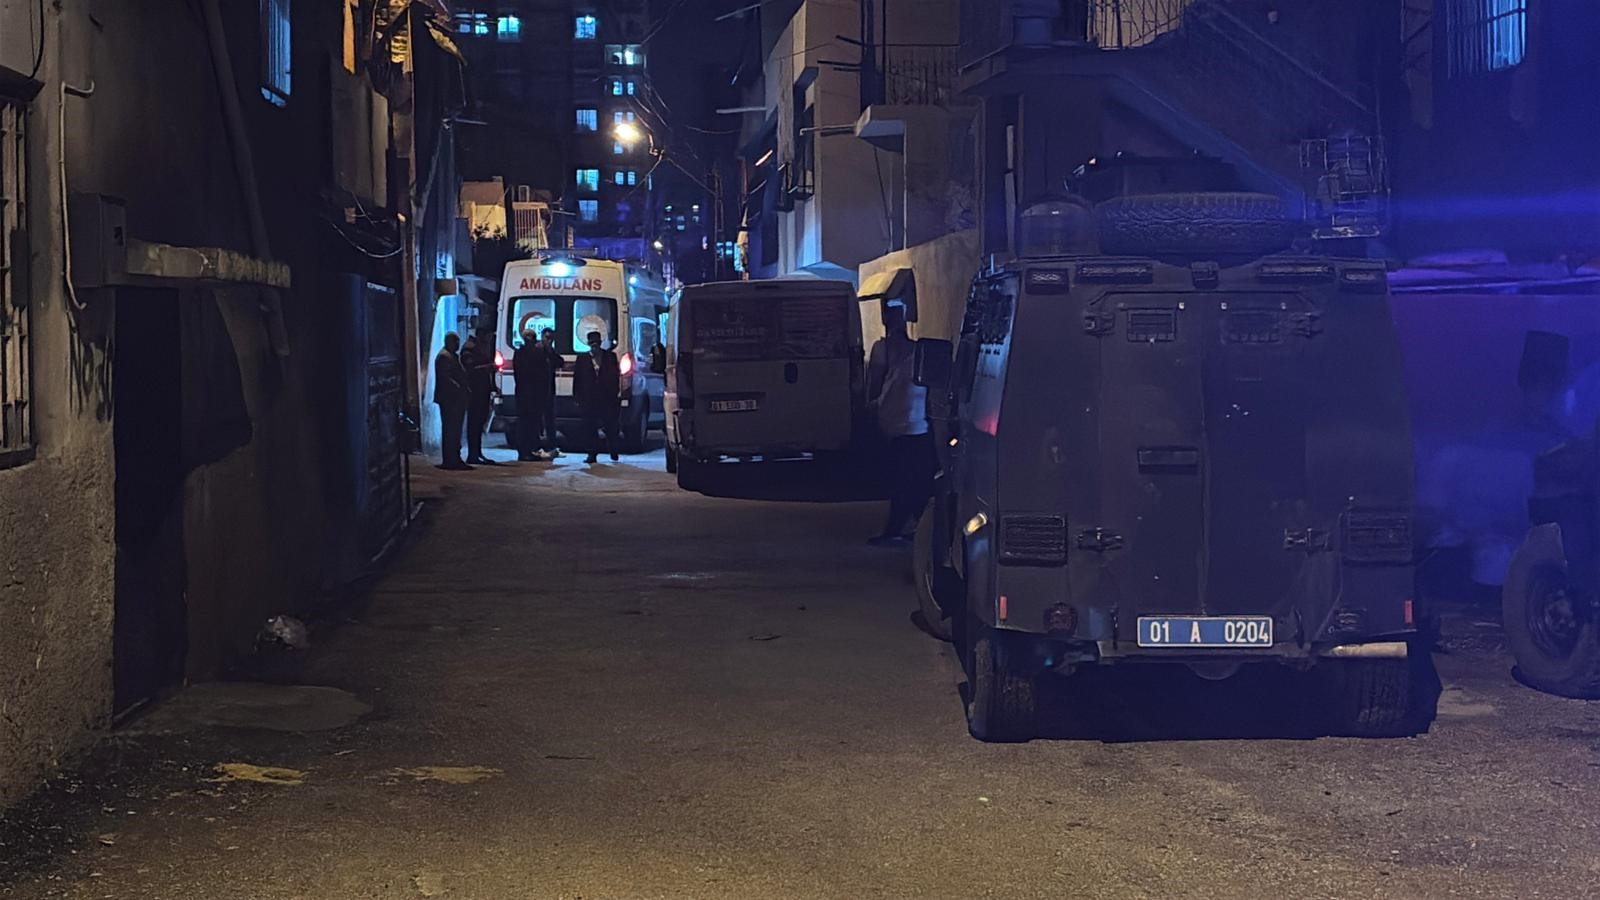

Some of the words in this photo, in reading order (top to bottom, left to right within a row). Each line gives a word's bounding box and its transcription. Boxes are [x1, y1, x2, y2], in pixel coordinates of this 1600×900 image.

[520, 278, 602, 291] AMBULANS
[1150, 621, 1170, 643] 01
[1190, 621, 1201, 643] A
[1224, 621, 1269, 643] 0204
